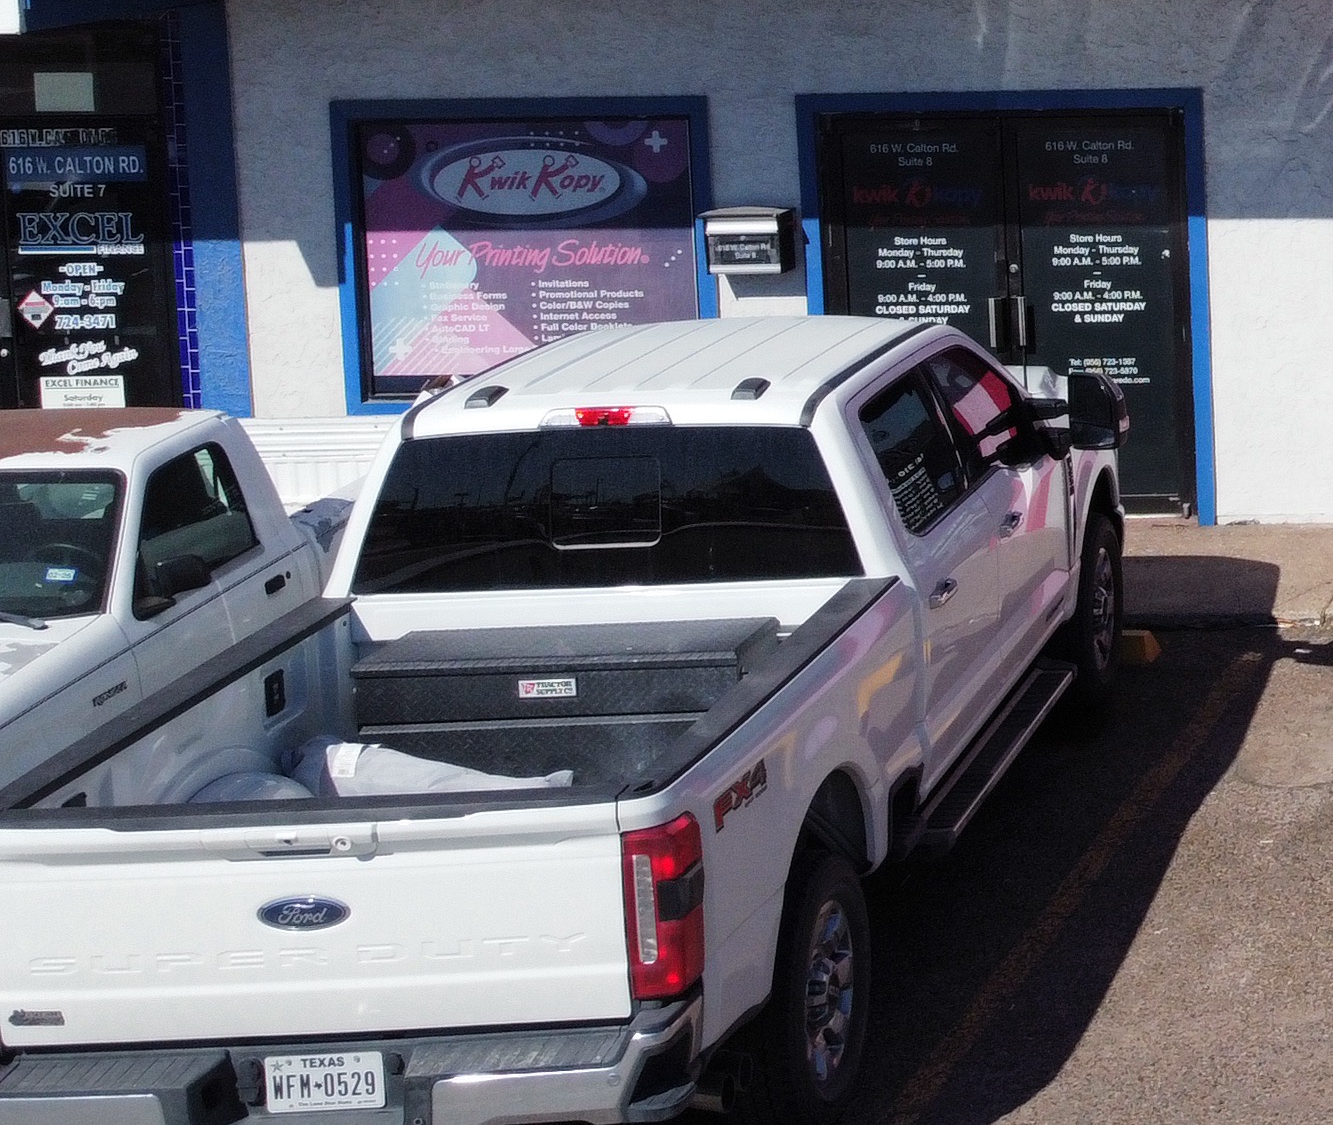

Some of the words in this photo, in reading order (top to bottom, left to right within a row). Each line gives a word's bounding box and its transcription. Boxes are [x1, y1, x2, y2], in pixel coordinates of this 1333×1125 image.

[870, 143, 888, 154] 616
[907, 143, 940, 154] Calton
[1045, 141, 1064, 151] 616
[898, 157, 923, 167] Suite
[1073, 154, 1099, 164] Suite
[9, 157, 33, 174] 616
[55, 156, 114, 174] CALTON
[119, 156, 144, 174] RD.
[455, 155, 531, 203] Kwik
[529, 154, 603, 203] Kopy
[50, 184, 94, 197] SUITE
[98, 185, 106, 197] 7
[16, 212, 145, 244] EXCEL
[894, 236, 918, 246] Store
[920, 236, 947, 246] Hours
[1069, 234, 1094, 243] Store
[1096, 233, 1122, 243] Hours
[878, 248, 915, 259] Monday
[921, 248, 964, 259] Thursday
[1054, 245, 1090, 256] Monday
[1099, 245, 1140, 256] Thursday
[415, 241, 464, 279] Your
[467, 241, 551, 273] Printing
[552, 239, 642, 266] Solution
[1052, 257, 1071, 266] 9:00
[1102, 256, 1121, 266] 5:00
[41, 280, 84, 295] Monday
[91, 279, 125, 295] Friday
[538, 280, 589, 288] Invitations
[908, 282, 937, 293] Friday
[1084, 280, 1112, 290] Friday
[477, 292, 508, 300] Forms
[539, 290, 598, 299] Promotional
[600, 290, 644, 298] Products
[596, 300, 630, 310] Copies
[875, 306, 917, 315] CLOSED
[918, 305, 970, 314] SATURDAY
[1051, 303, 1092, 312] CLOSED
[1094, 302, 1146, 311] SATURDAY
[450, 314, 488, 322] Service
[540, 312, 579, 320] Internet
[581, 312, 617, 320] Access
[1084, 314, 1125, 323] SUNDAY
[55, 314, 117, 330] 724-3471
[541, 323, 559, 331] Full
[562, 323, 588, 331] Color
[478, 324, 490, 332] LT
[45, 379, 73, 388] EXCEL
[76, 378, 120, 388] FINANCE
[713, 758, 767, 834] FX4
[277, 901, 328, 929] Ford
[30, 944, 329, 976] SUPER
[357, 931, 588, 967] DUTY
[300, 1056, 345, 1068] TEXAS
